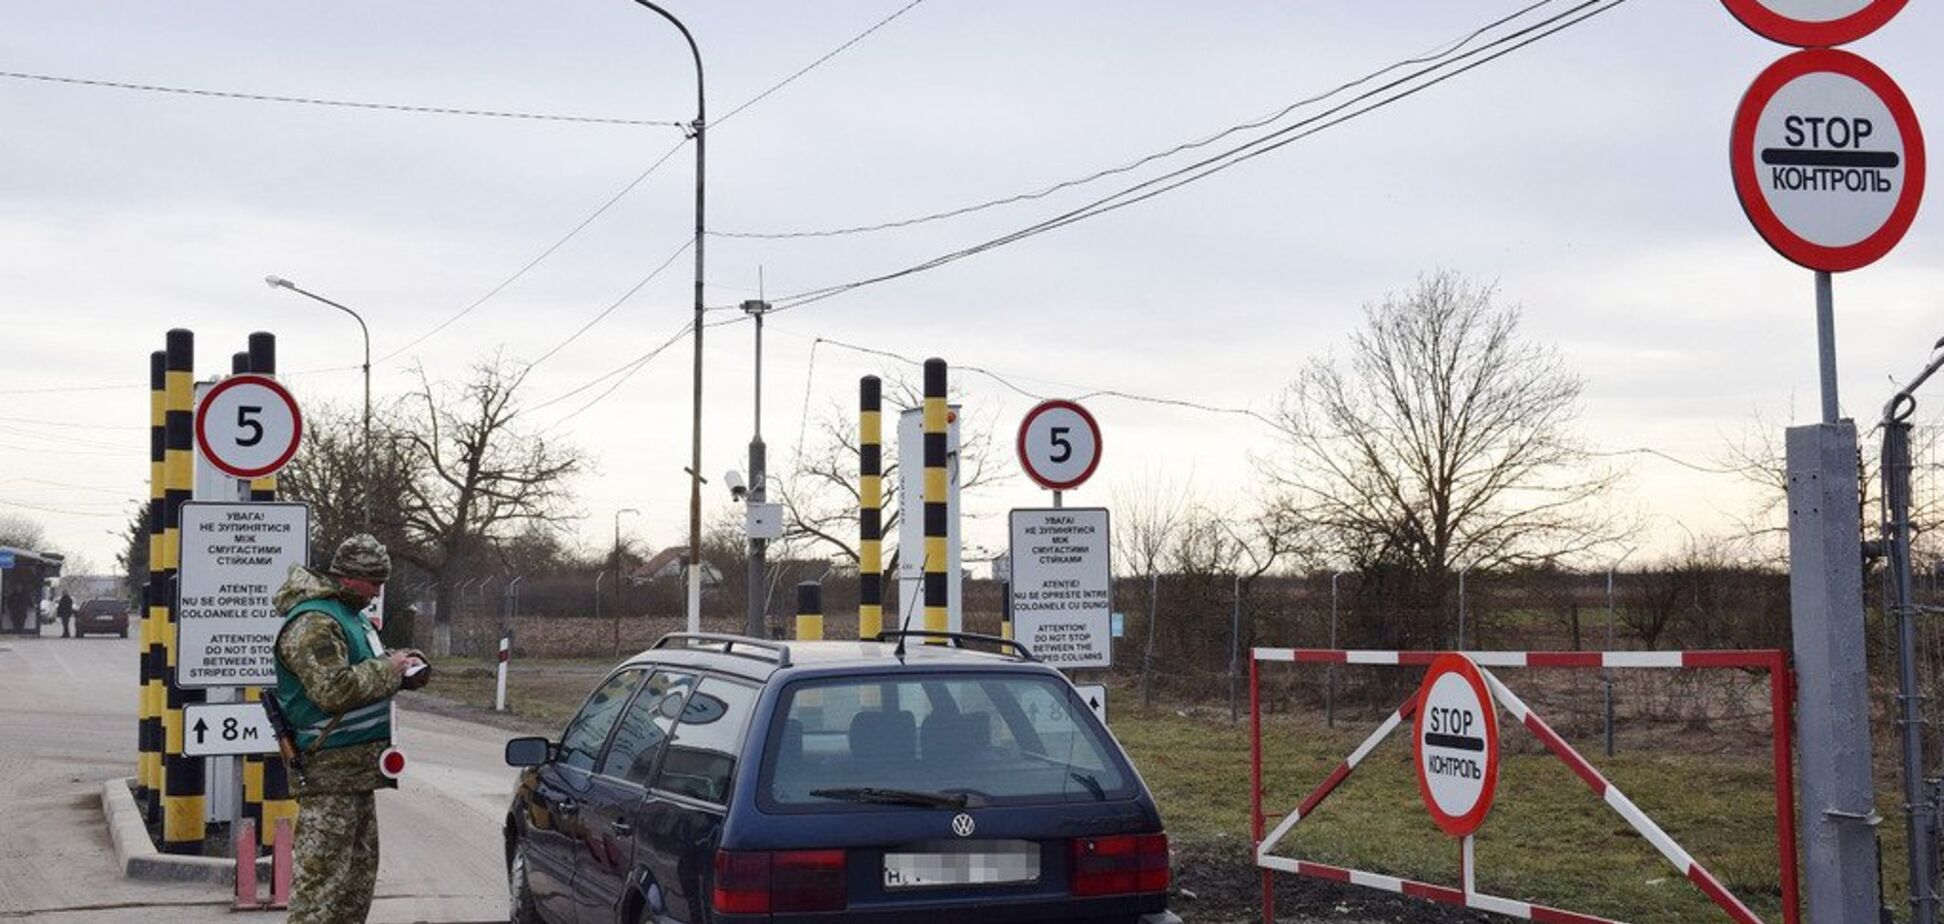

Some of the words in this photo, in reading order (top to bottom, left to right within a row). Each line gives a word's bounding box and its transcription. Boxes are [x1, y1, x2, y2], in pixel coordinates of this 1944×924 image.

[1785, 115, 1872, 148] STOP
[1773, 166, 1892, 192] КОНТРОЛЬ
[235, 406, 263, 447] 5
[1050, 427, 1072, 463] 5
[226, 512, 265, 521] УВАГА!
[1045, 516, 1075, 525] УВАГА!
[200, 523, 214, 532] НЕ
[218, 523, 290, 533] ЗУПИНЯТИСЯ
[1039, 526, 1095, 534] ЗУПИНЯТИСЯ
[234, 535, 256, 543] МІЖ
[208, 545, 282, 554] СМУГАСТИМИ
[217, 556, 273, 565] СТІЙКАМИ
[1015, 592, 1026, 600] NU
[182, 597, 197, 606] NU
[201, 597, 215, 606] SE
[1015, 602, 1066, 610] COLOANELE
[181, 609, 248, 618] COLOANELE
[251, 609, 267, 618] CU
[1039, 624, 1086, 632] ATTENTION!
[210, 634, 275, 643] ATTENTION!
[1035, 634, 1047, 642] DO
[1049, 633, 1065, 642] NOT
[1069, 633, 1091, 642] STOP
[205, 645, 222, 655] DO
[225, 645, 246, 655] NOT
[1033, 644, 1074, 652] BETWEEN
[1077, 643, 1091, 651] THE
[1062, 652, 1102, 661] COLUMNS
[203, 657, 256, 666] BETWEEN
[260, 657, 273, 666] TH
[190, 668, 236, 678] STRIPED
[1431, 707, 1473, 735] STOP
[222, 718, 238, 740] 8
[1429, 755, 1481, 779] КОНТРОЛЬ
